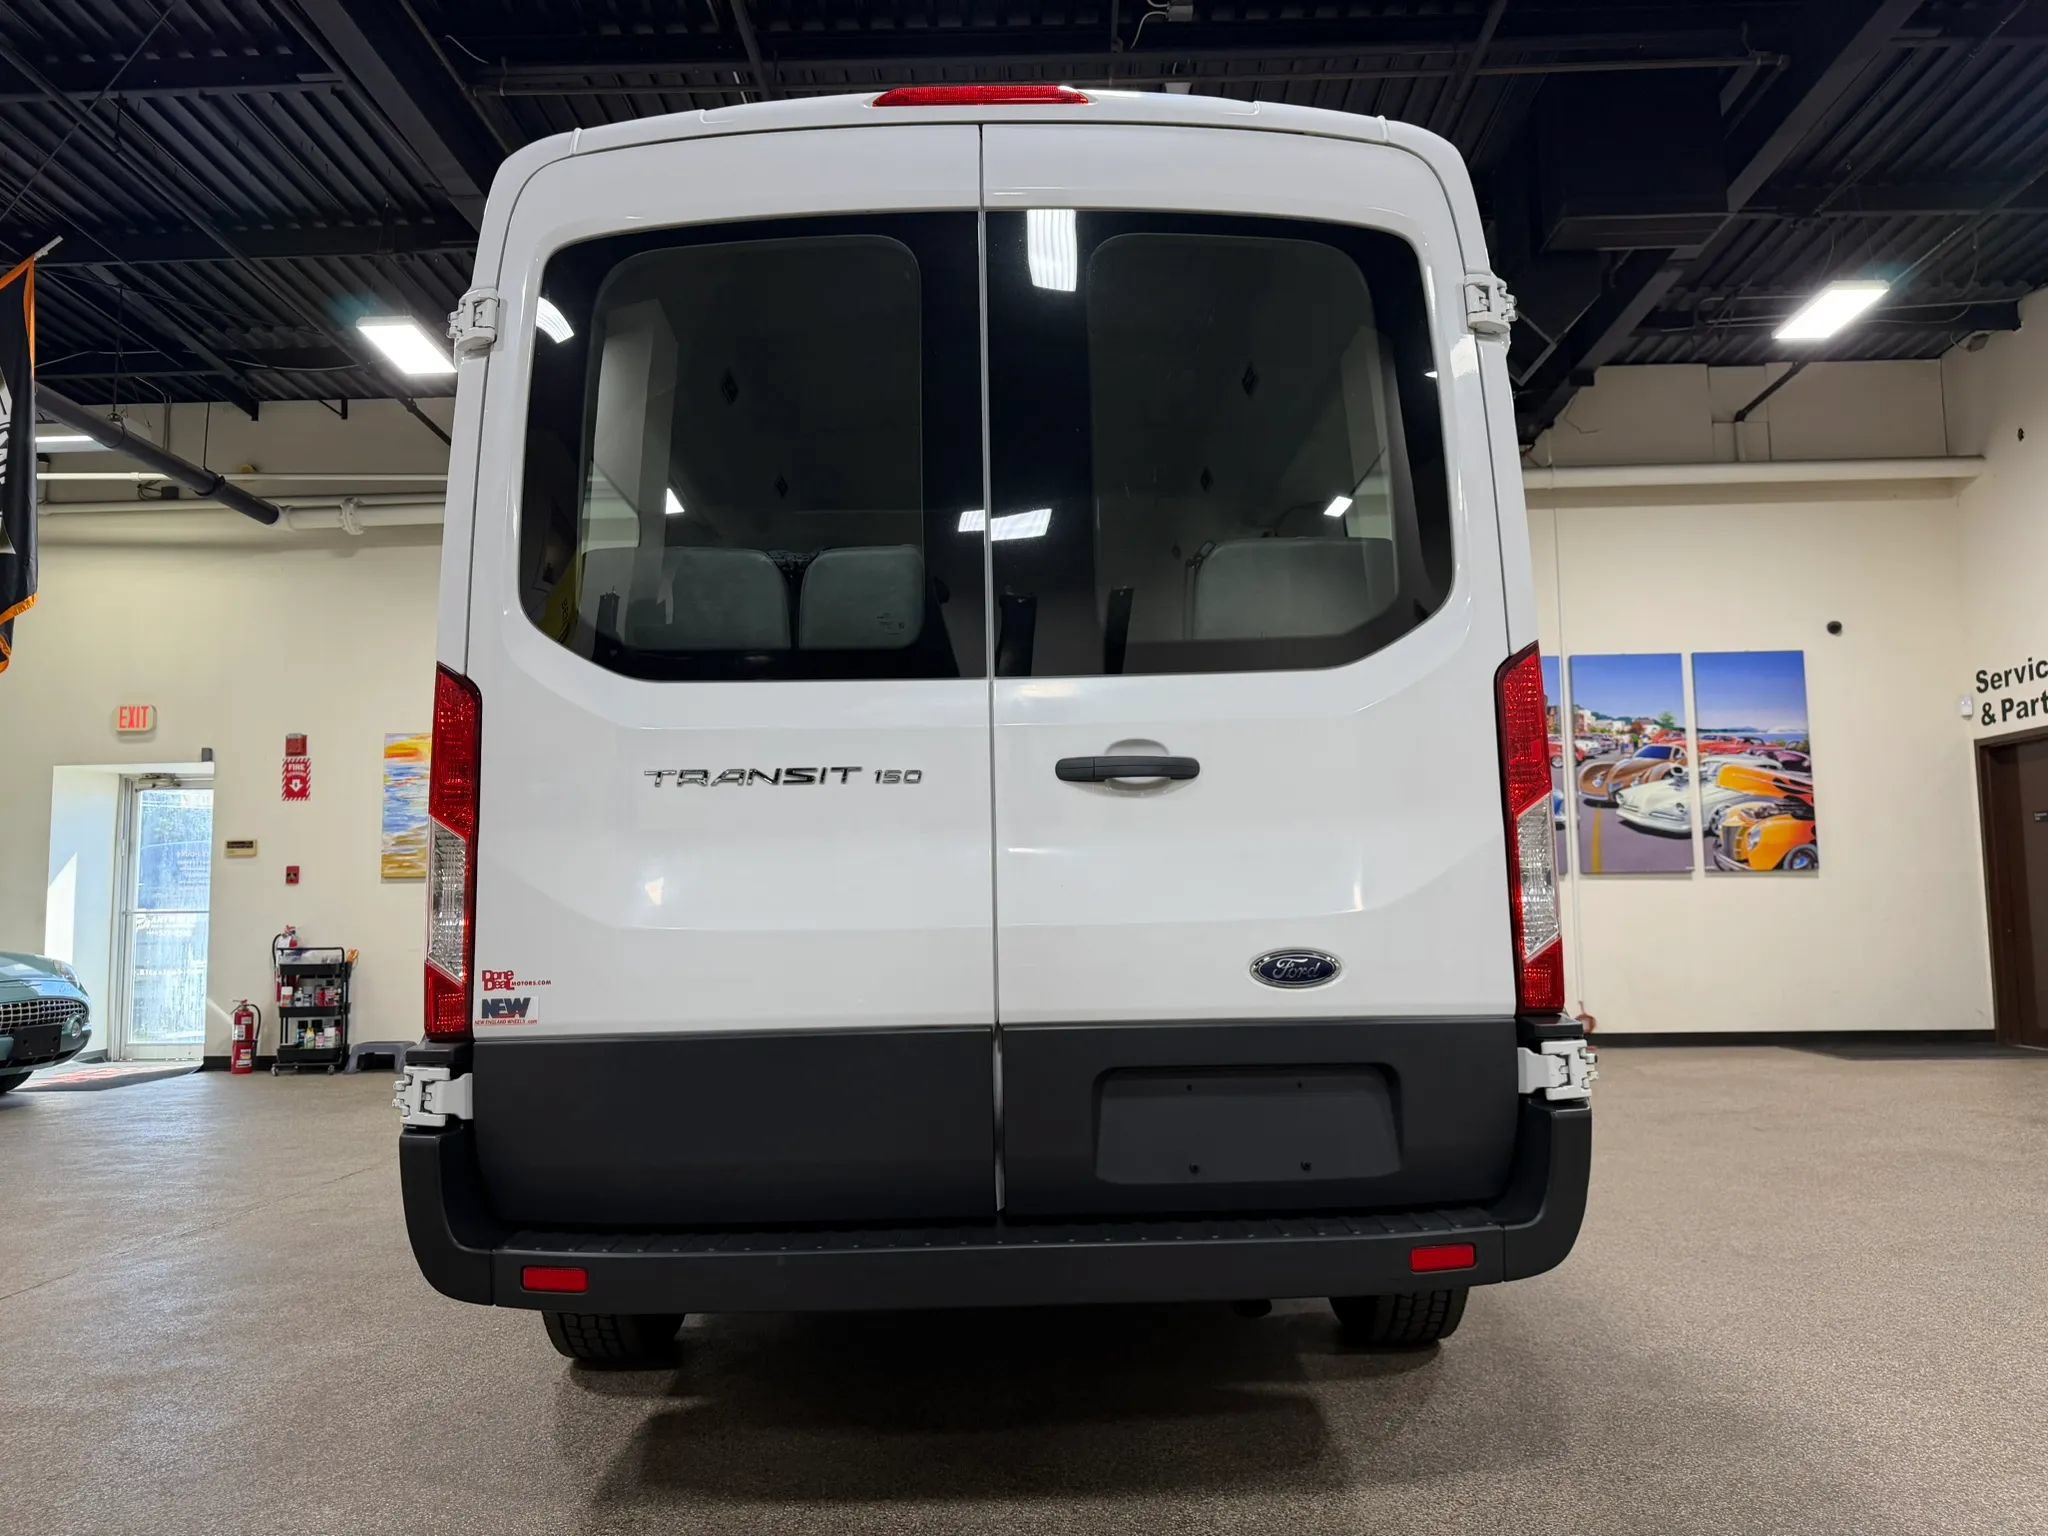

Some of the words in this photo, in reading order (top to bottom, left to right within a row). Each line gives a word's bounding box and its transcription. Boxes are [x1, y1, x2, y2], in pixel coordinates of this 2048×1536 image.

[1976, 657, 2048, 693] Servic
[119, 705, 149, 729] EXIT
[1981, 702, 1997, 726] &
[2001, 690, 2048, 722] Part
[288, 763, 305, 771] FIRE
[643, 766, 863, 787] TRANSIT
[874, 769, 923, 784] 150
[1272, 958, 1321, 979] Ford
[481, 997, 531, 1019] NEW
